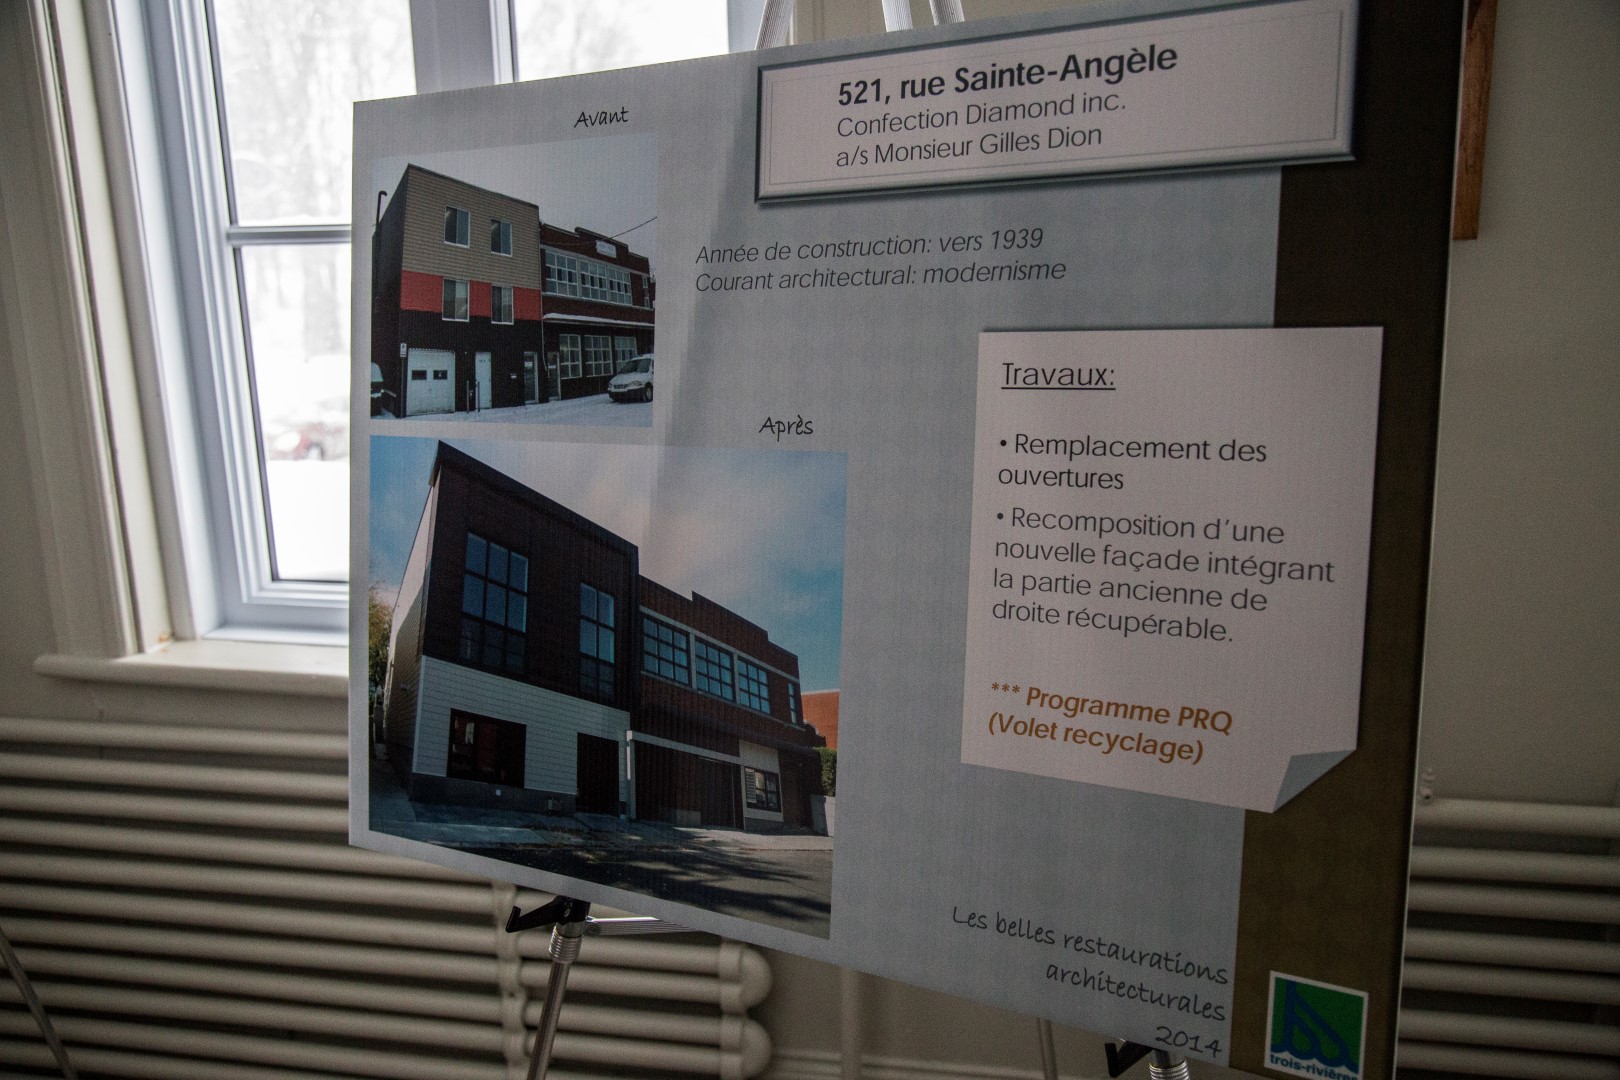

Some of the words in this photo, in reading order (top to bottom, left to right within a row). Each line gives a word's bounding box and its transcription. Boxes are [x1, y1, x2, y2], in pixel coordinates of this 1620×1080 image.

[838, 79, 892, 106] 521,
[900, 72, 945, 99] rue
[954, 43, 1178, 93] Sainte-Angèle
[574, 106, 630, 128] Avant
[837, 111, 958, 137] Confection
[966, 93, 1075, 125] Diamond
[1082, 91, 1127, 114] inc.
[836, 144, 869, 168] a/s
[874, 138, 974, 165] Monsieur
[979, 132, 1041, 155] Gilles
[1048, 125, 1102, 149] Dion
[695, 244, 760, 265] Année
[764, 241, 791, 261] de
[797, 235, 932, 260] construction:
[938, 232, 983, 253] vers
[989, 228, 1044, 251] 1939
[695, 271, 773, 292] Courant
[778, 265, 917, 290] architectural:
[922, 260, 1067, 284] modernisme
[1002, 362, 1117, 390] Travaux:
[758, 414, 814, 442] Après
[1014, 434, 1211, 462] Remplacement
[1219, 439, 1267, 462] des
[998, 467, 1124, 490] ouvertures
[1011, 507, 1195, 538] Recomposition
[1203, 518, 1285, 544] d'une
[995, 539, 1095, 564] nouvelle
[1102, 544, 1199, 572] façade
[1208, 552, 1335, 585] intégrant
[993, 568, 1013, 589] la
[1021, 571, 1091, 596] partie
[1100, 579, 1223, 607] ancienne
[1230, 587, 1267, 612] de
[992, 599, 1060, 625] droite
[1067, 608, 1234, 643] récupérable.
[1026, 686, 1171, 725] Programme
[1178, 706, 1234, 734] PRQ
[988, 712, 1058, 741] (Volet
[1063, 727, 1204, 766] recyclage)
[952, 906, 988, 930] Les
[996, 912, 1056, 945] belles
[1063, 933, 1229, 985] restaurations
[1045, 962, 1227, 1022] architecturales
[1155, 1026, 1222, 1058] 2014
